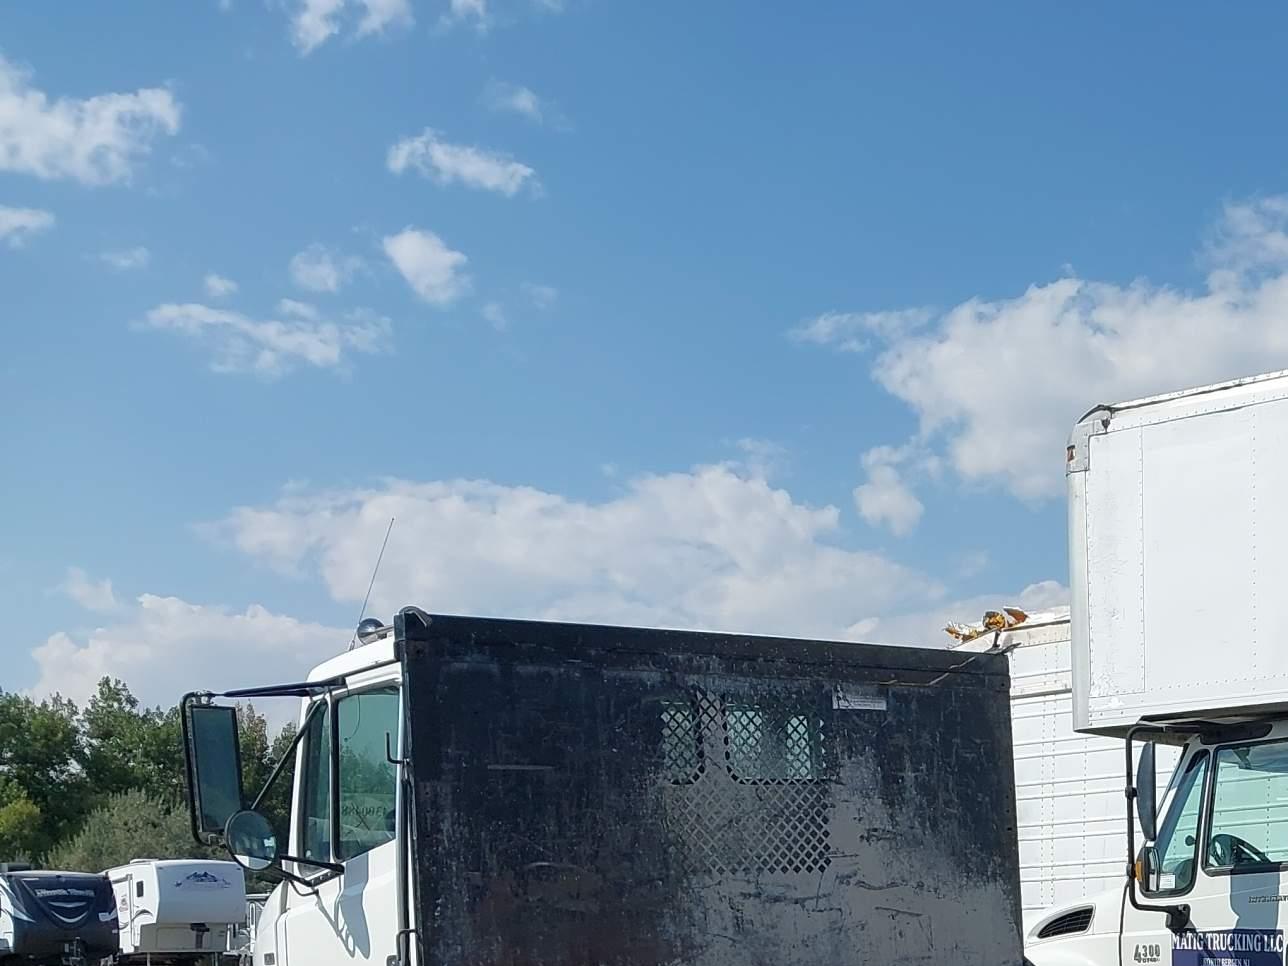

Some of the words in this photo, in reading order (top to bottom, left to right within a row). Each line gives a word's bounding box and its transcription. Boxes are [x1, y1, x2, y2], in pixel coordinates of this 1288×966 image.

[1206, 933, 1262, 952] TRUCKING
[1264, 935, 1284, 953] LLC
[1134, 944, 1161, 963] 4300
